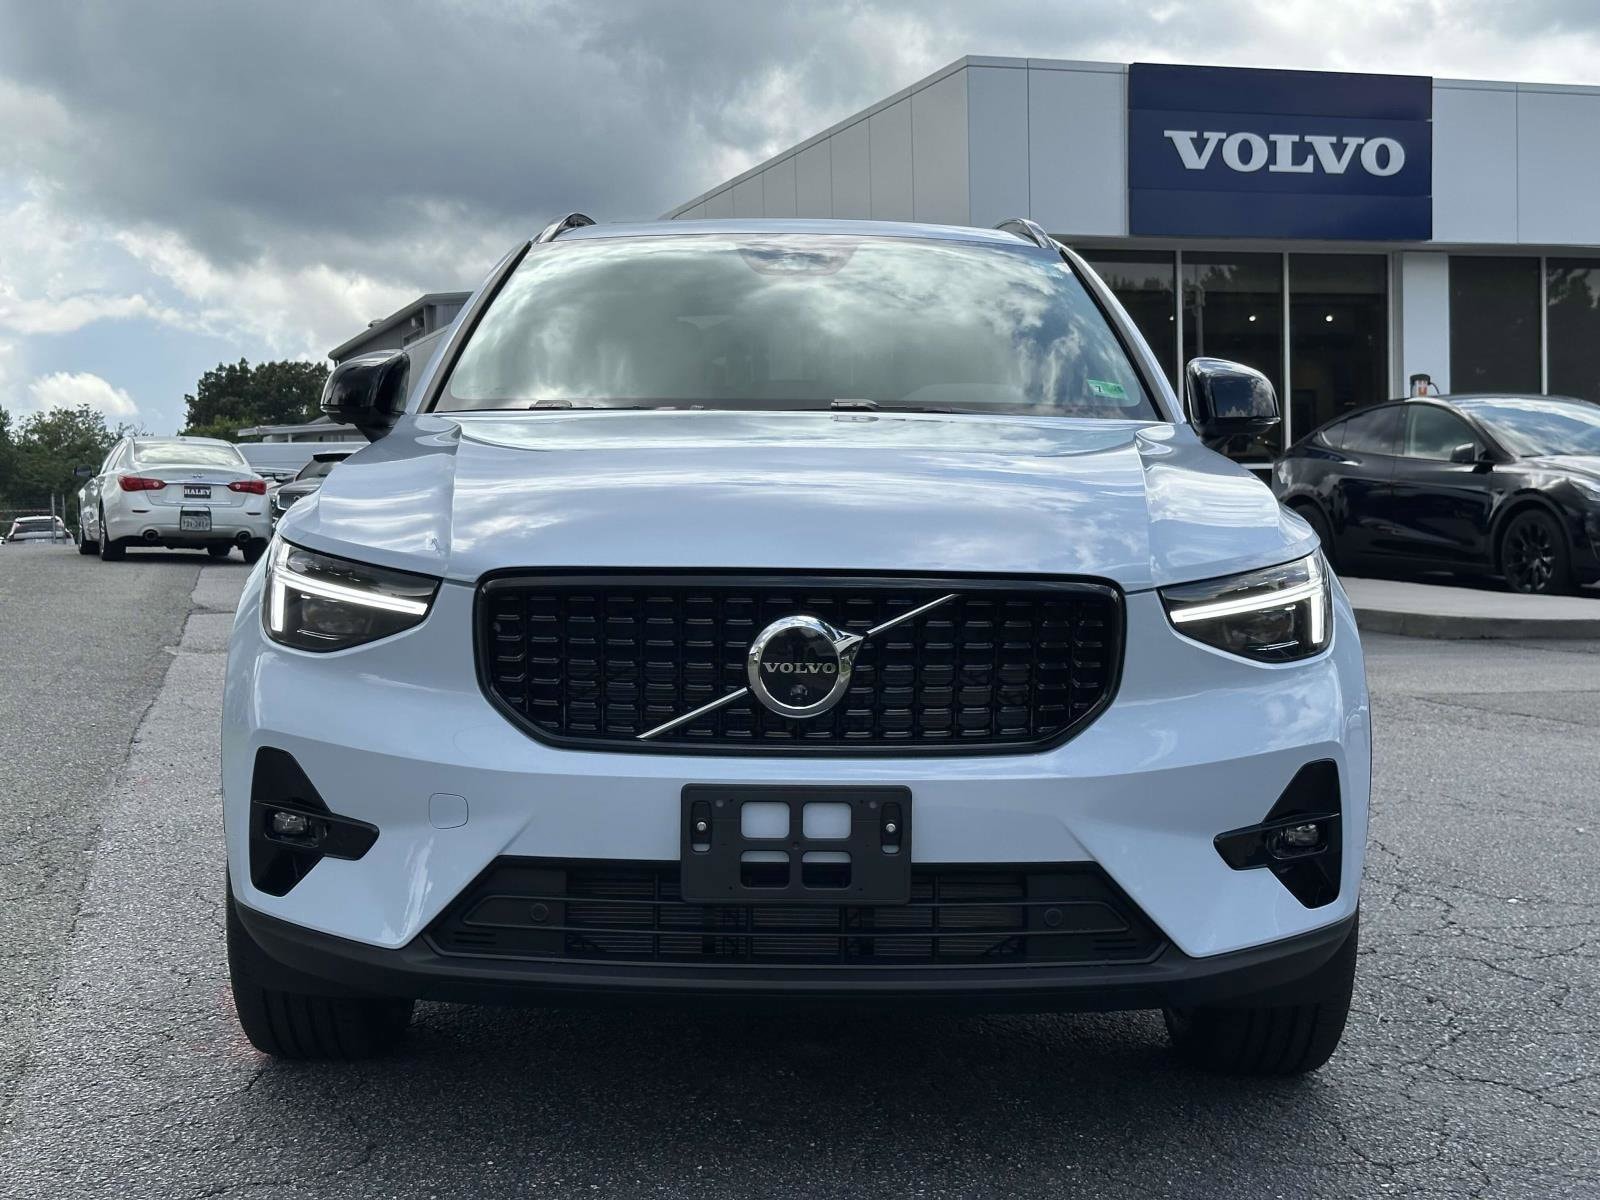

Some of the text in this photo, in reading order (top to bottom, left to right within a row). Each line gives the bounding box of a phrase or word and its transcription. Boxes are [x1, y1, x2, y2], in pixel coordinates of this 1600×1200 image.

[1163, 129, 1406, 177] VOLVO
[184, 488, 211, 496] HALEY
[762, 661, 837, 674] VOLVO
